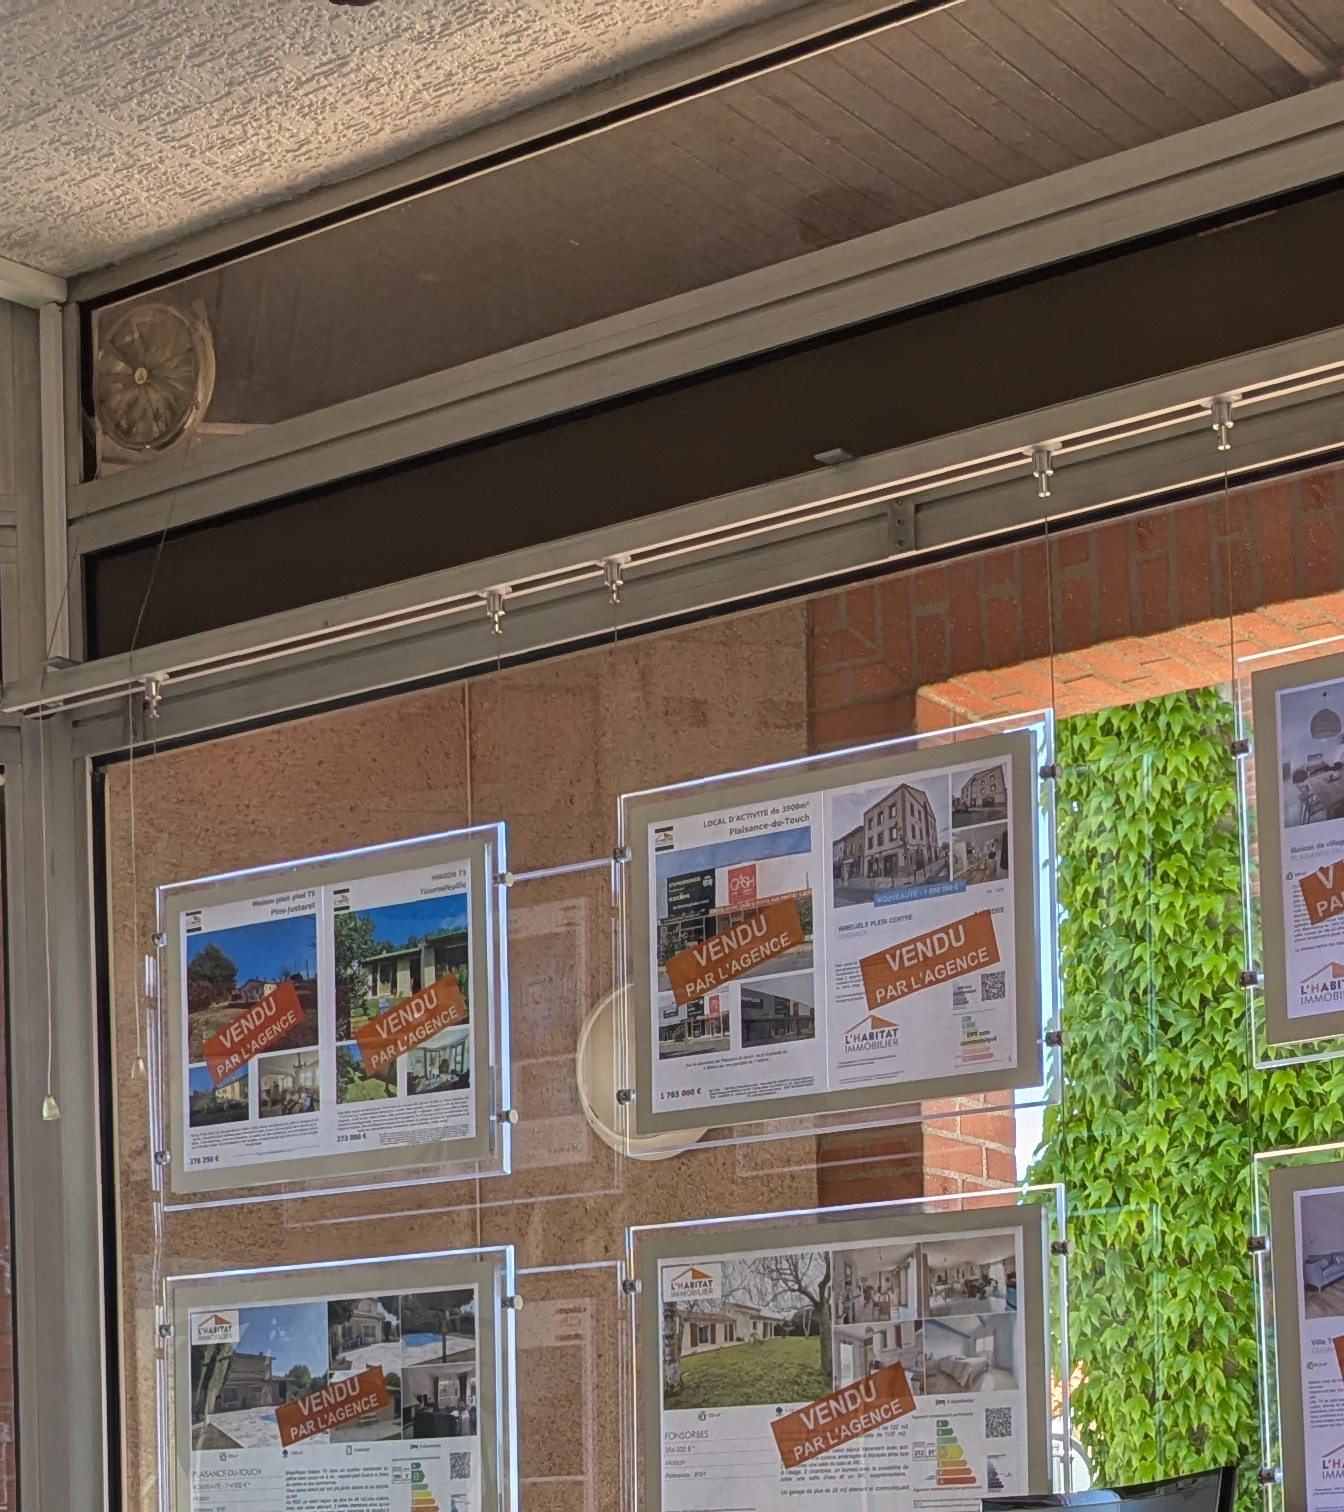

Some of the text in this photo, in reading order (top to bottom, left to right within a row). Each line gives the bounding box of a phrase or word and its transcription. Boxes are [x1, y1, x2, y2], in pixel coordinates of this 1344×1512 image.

[730, 814, 809, 836] Plaisance-du-Touch
[685, 932, 790, 998] PAR L'AGENCE
[693, 915, 767, 967] VENDU
[886, 925, 965, 972] VENDU
[876, 947, 989, 1003] PAR L'AGENCE
[218, 996, 277, 1049] VENDU
[370, 1005, 458, 1068] PAR L'AGENCE
[375, 989, 437, 1040] VENDU
[845, 1028, 899, 1044] L'HABITAT
[216, 1010, 297, 1077] PAR L'AGENCE
[845, 1038, 899, 1053] IMMOBILIER
[671, 1280, 713, 1290] L'HABITAT
[290, 1393, 379, 1440] PAR L'AGENCE
[298, 1376, 360, 1416] VENDU
[799, 1380, 876, 1431] VENDU
[793, 1438, 826, 1461] PAR
[829, 1399, 902, 1446] L'AGENCE
